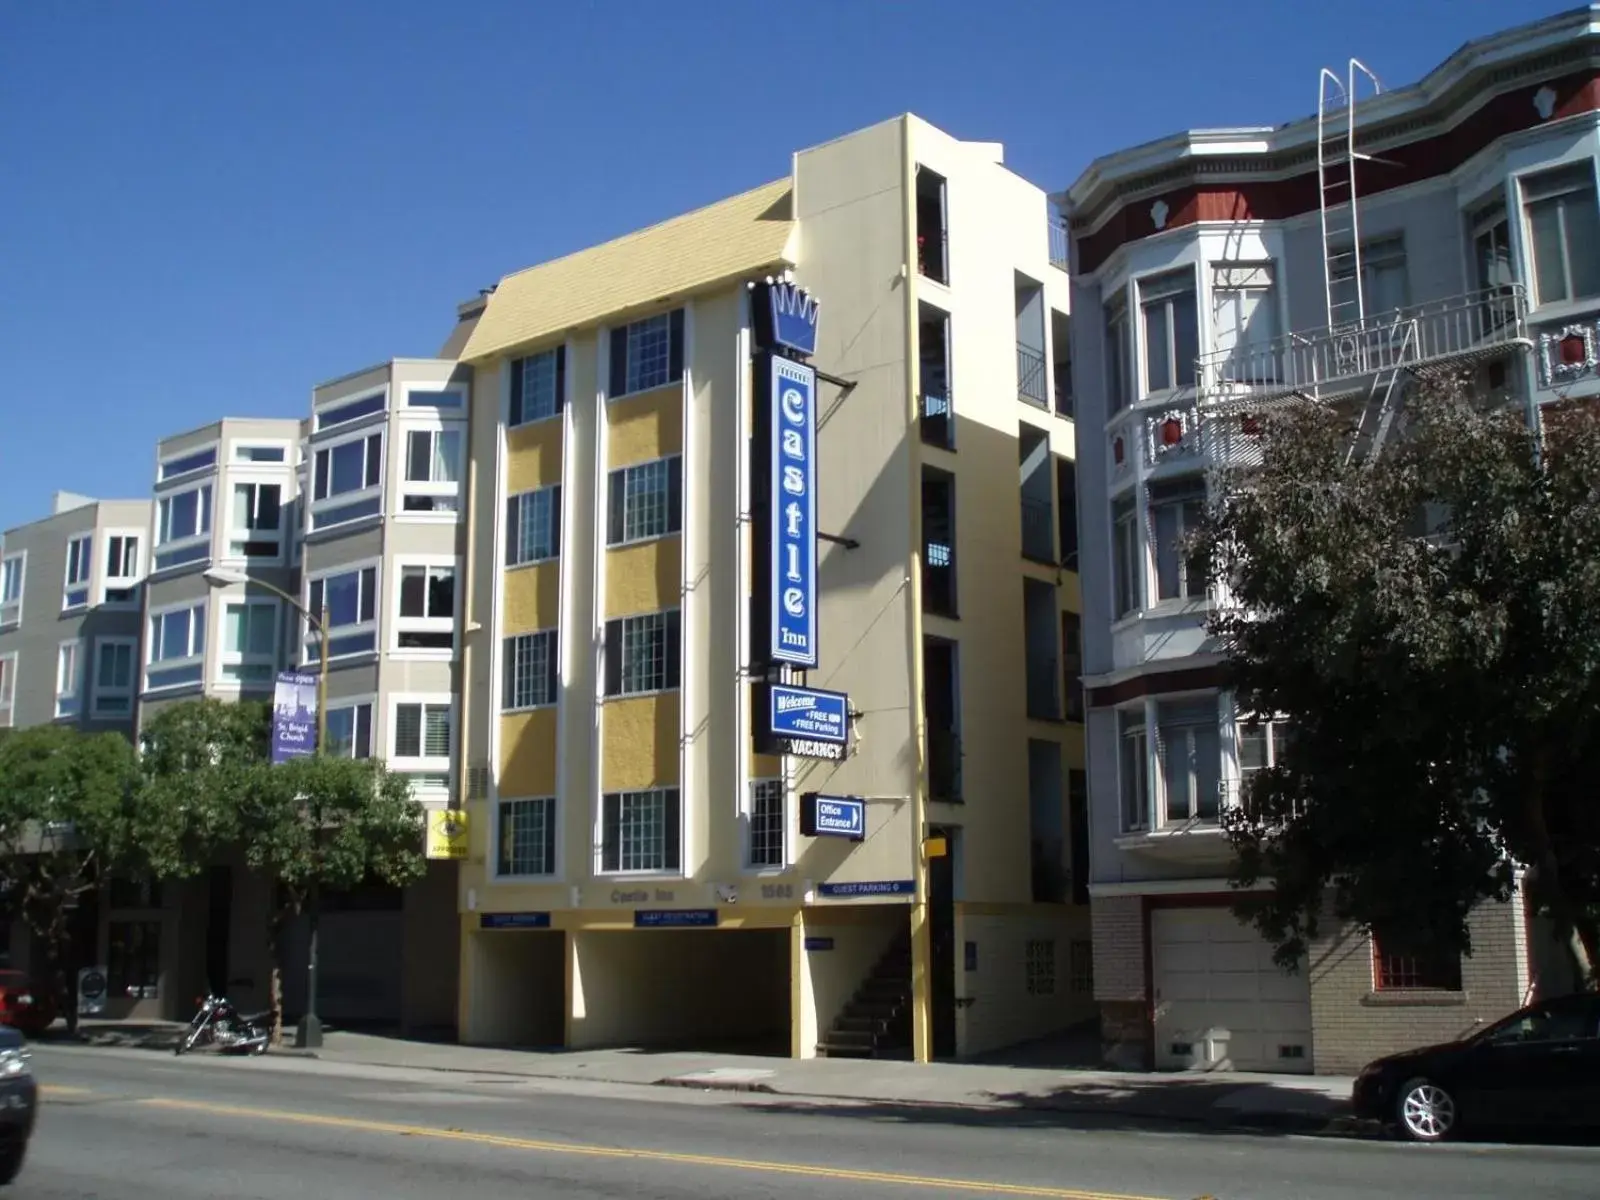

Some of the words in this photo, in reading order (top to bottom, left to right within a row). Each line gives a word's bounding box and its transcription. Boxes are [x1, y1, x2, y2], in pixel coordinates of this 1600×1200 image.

[781, 388, 805, 617] Castle
[781, 626, 807, 647] Inn
[777, 695, 816, 710] Welcome
[810, 711, 828, 721] FREE
[796, 719, 815, 730] FREE
[815, 722, 839, 735] Parking
[791, 739, 843, 758] VACANCY
[820, 804, 842, 816] Office
[820, 816, 851, 828] Entrance
[832, 884, 857, 894] GUEST
[859, 883, 892, 893] PARKING
